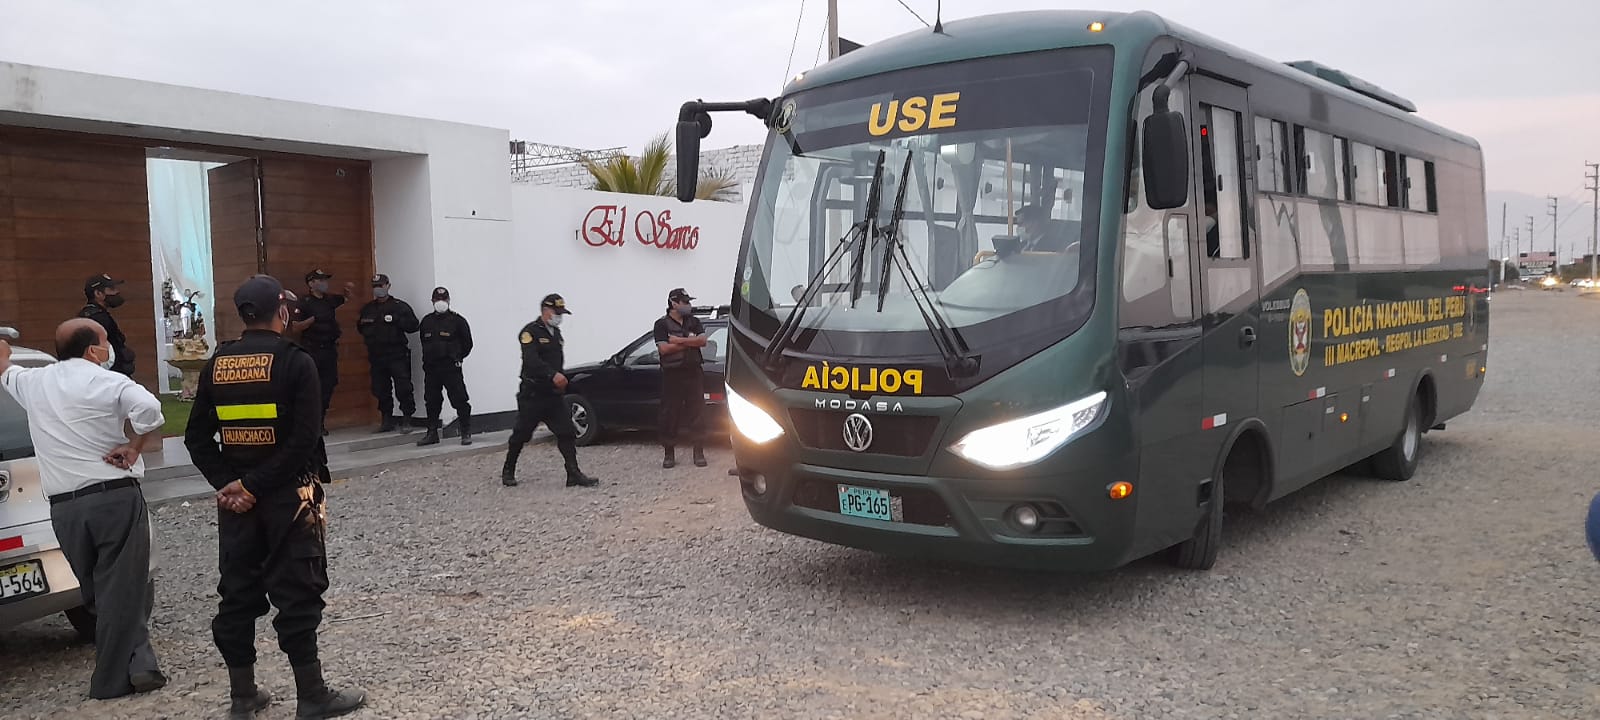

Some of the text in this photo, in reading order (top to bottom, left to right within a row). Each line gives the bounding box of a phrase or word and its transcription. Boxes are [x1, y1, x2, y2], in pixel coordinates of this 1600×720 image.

[868, 92, 960, 136] USE
[582, 205, 699, 250] El Sarco
[1324, 298, 1374, 338] POLICÍA
[1376, 299, 1426, 330] NACIONAL
[1428, 297, 1444, 321] DEL
[1325, 345, 1335, 367] III
[1337, 337, 1380, 365] MACREPOL
[1386, 331, 1413, 352] REGPOL
[1413, 329, 1423, 347] LA
[1423, 324, 1450, 345] LIBERTAD
[217, 356, 268, 370] SEGURIDAD
[215, 368, 267, 382] CIUDADANA
[815, 398, 903, 412] MODASA
[225, 430, 271, 442] HUANCHACO
[848, 494, 888, 515] PG-165
